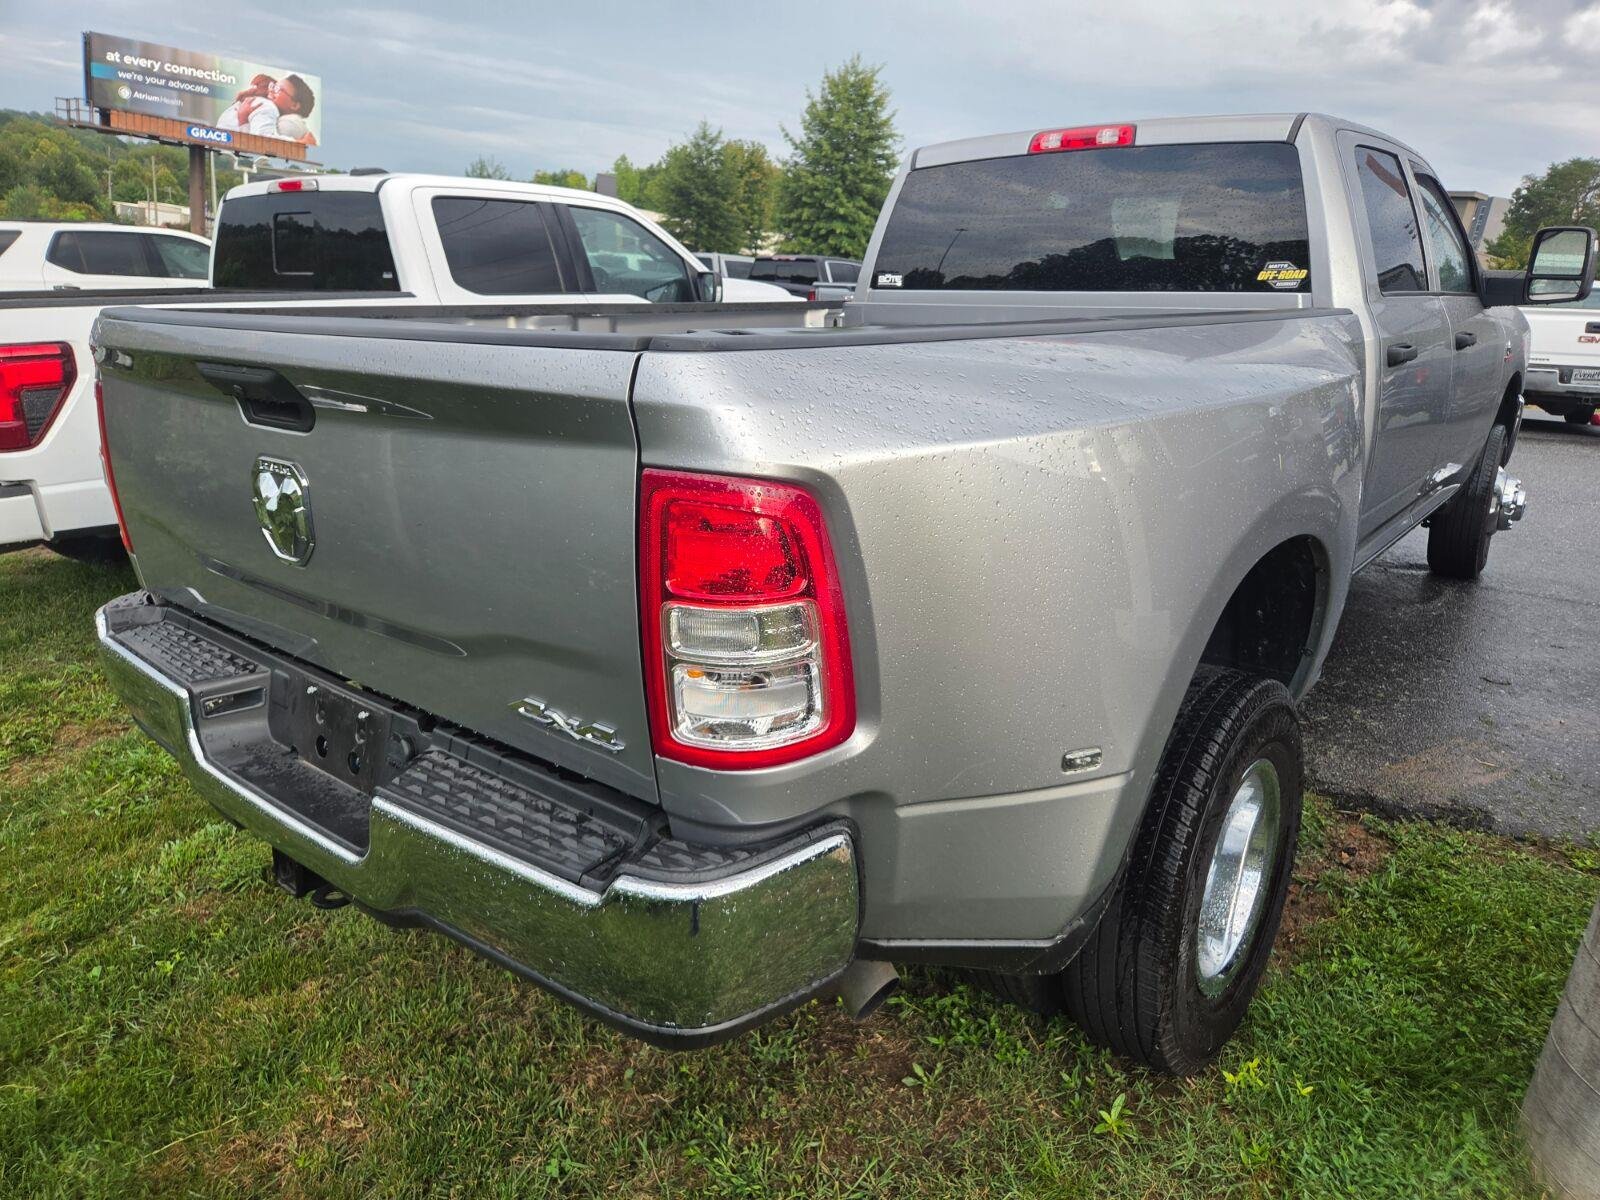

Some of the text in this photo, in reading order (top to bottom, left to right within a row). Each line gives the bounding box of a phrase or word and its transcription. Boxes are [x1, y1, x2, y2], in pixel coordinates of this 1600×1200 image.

[106, 51, 236, 85] at every connection
[117, 70, 210, 94] we're your advocate
[190, 126, 228, 142] GRACE
[1257, 269, 1308, 281] OFF-ROAD
